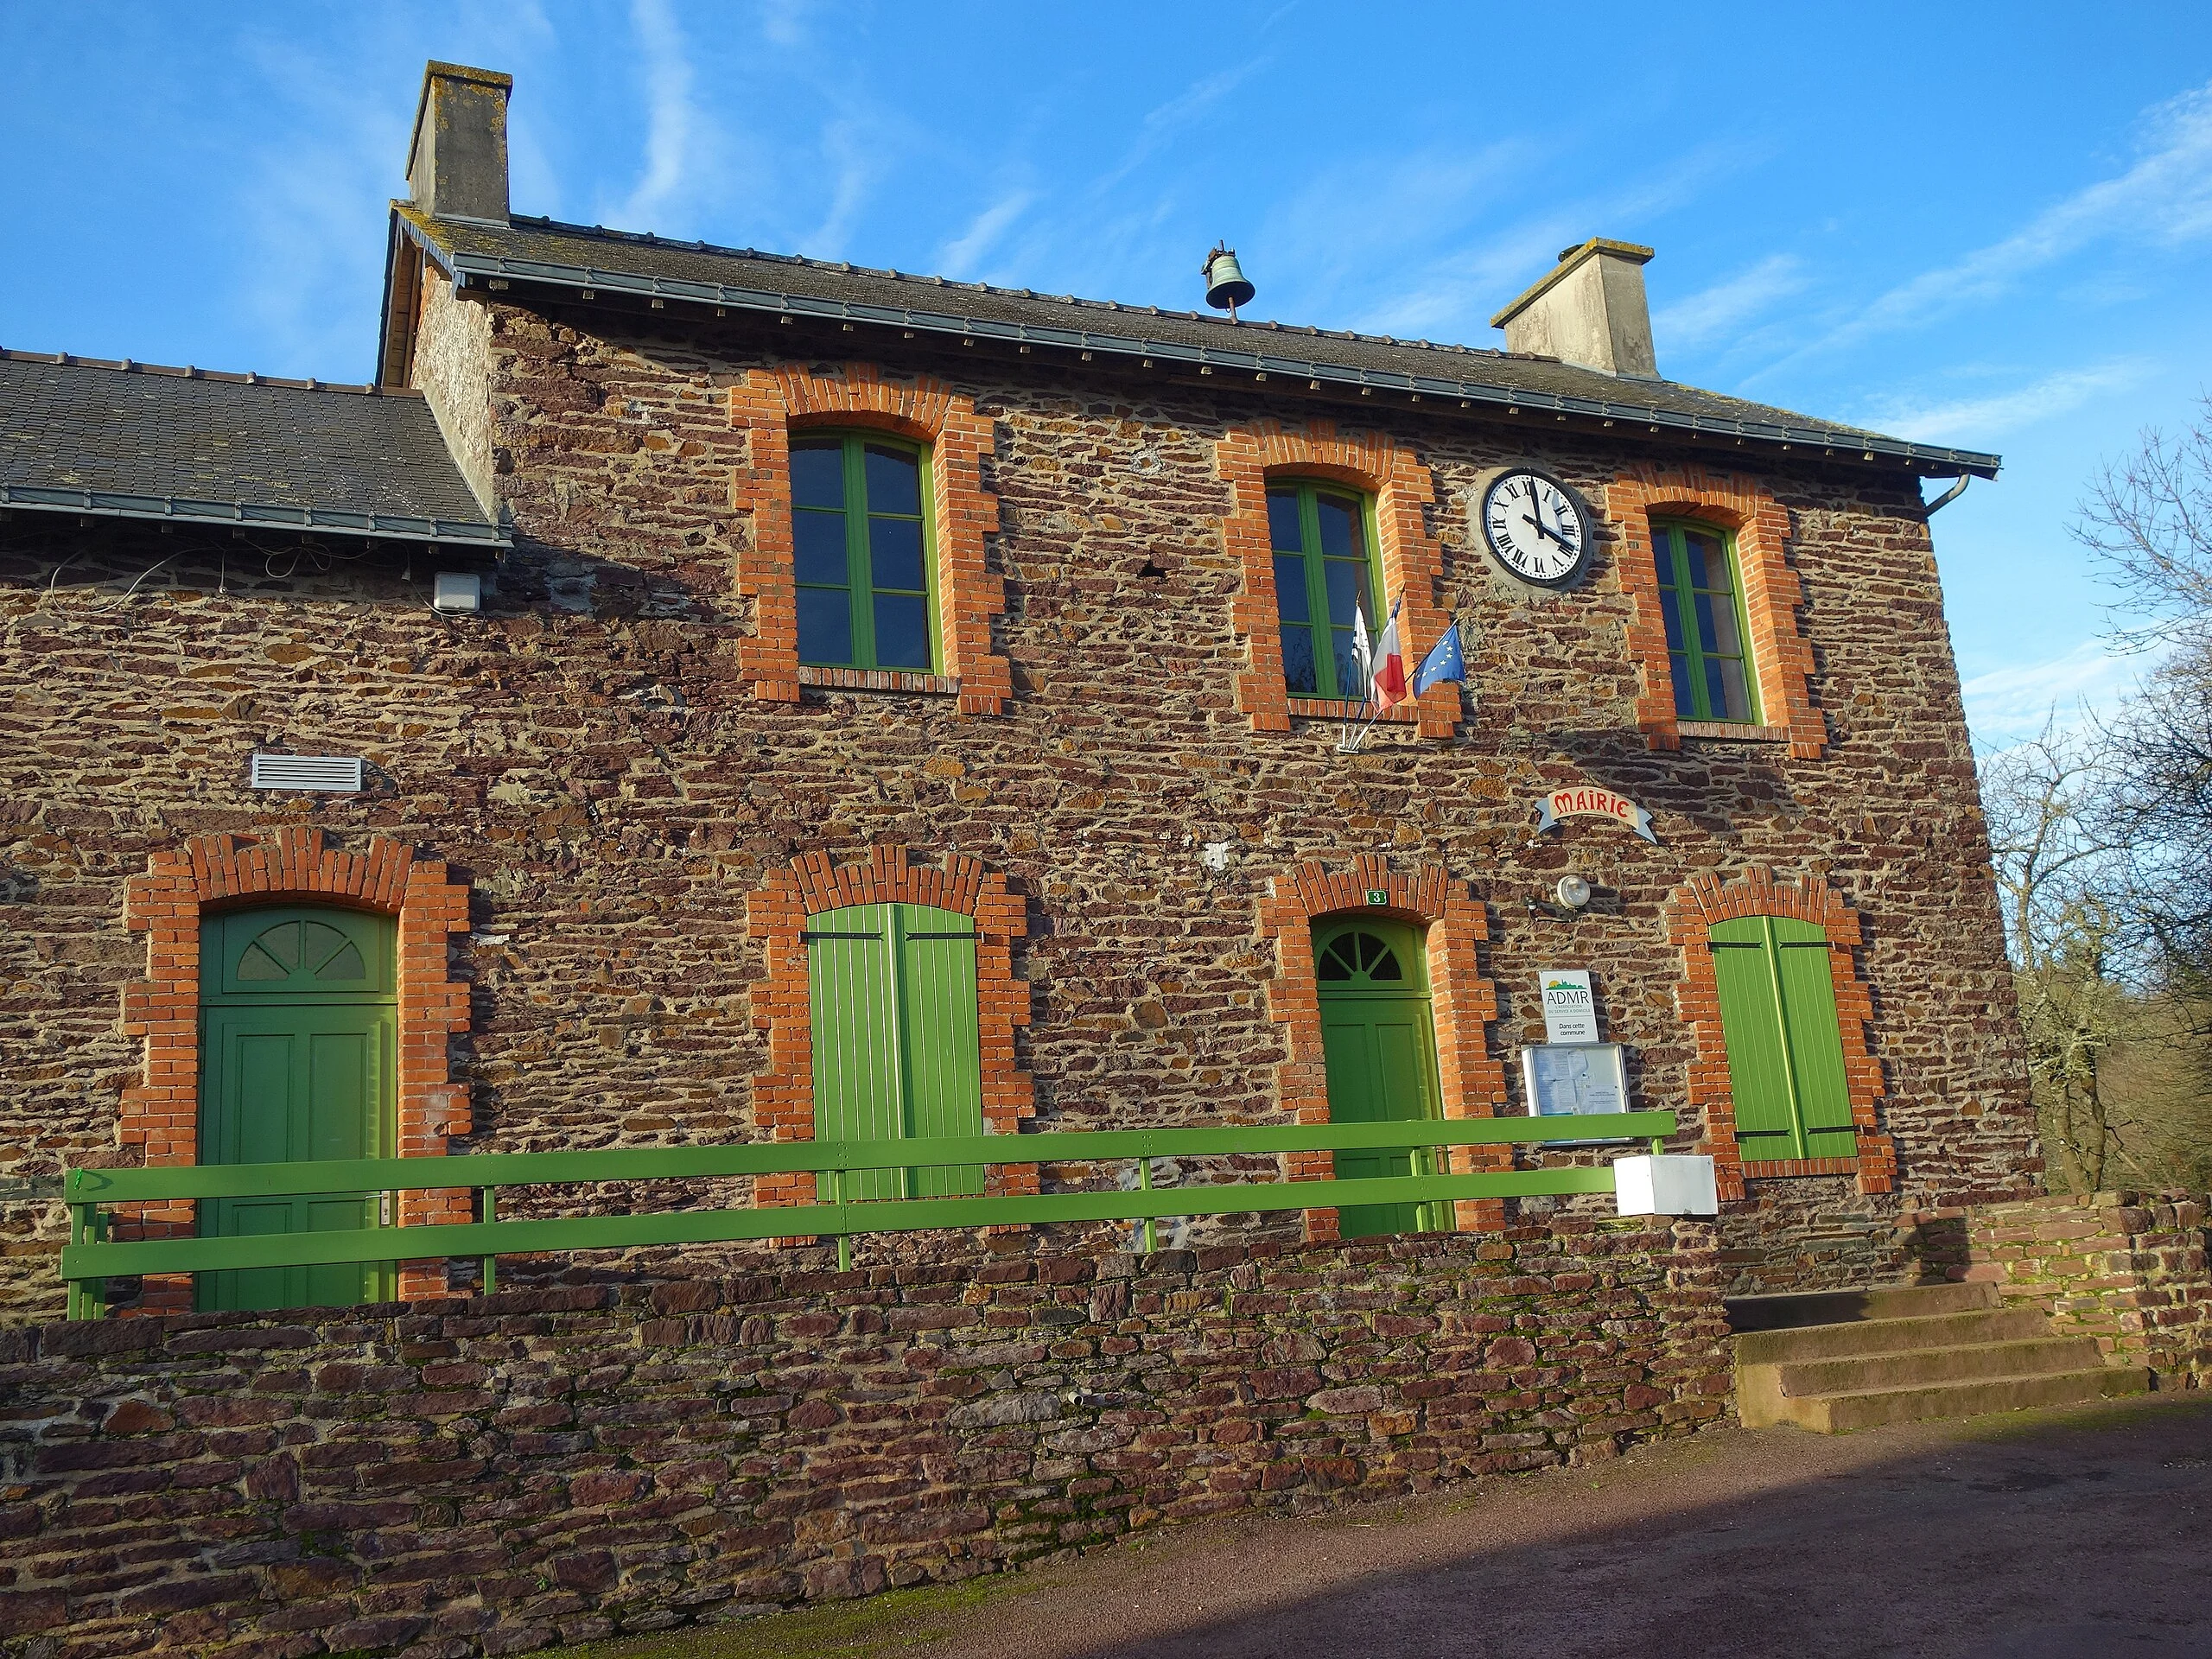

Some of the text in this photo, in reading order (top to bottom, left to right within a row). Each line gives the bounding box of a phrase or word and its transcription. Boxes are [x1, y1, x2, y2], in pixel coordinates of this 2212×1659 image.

[1493, 496, 1510, 513] X
[1554, 505, 1569, 518] II
[1560, 523, 1577, 537] III
[1511, 547, 1529, 569] VII
[1533, 557, 1546, 573] VI
[1552, 555, 1565, 570] V
[1373, 892, 1381, 903] 3
[1547, 990, 1590, 1004] ADMR
